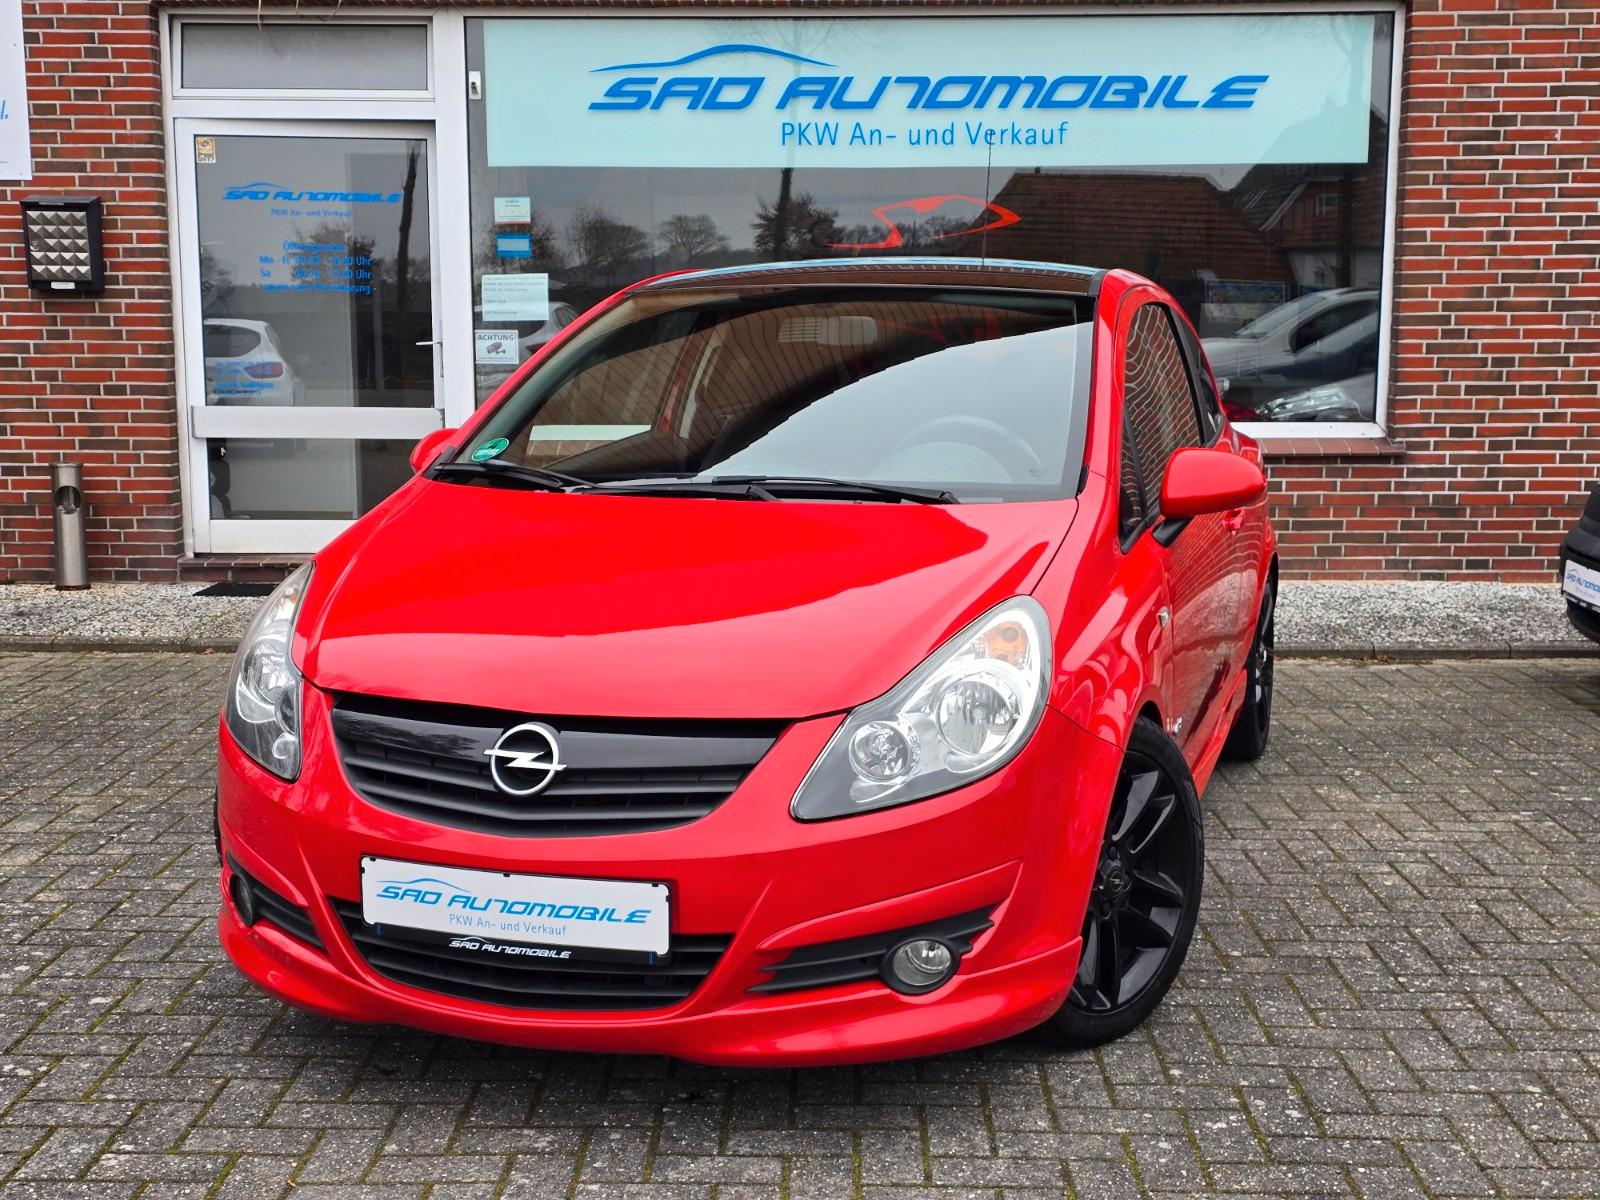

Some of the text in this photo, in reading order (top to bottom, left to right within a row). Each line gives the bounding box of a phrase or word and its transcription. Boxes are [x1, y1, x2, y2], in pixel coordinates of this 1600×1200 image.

[588, 75, 1269, 110] SAD AUTOMOBILE
[781, 121, 1069, 146] PKW An- und Verkauf
[273, 192, 403, 203] AUTOMOBILE
[377, 886, 652, 924] SAD AUTOMOBILE
[450, 913, 567, 936] PKW An- und Verkauf
[482, 944, 572, 959] AUTOMOBILE
